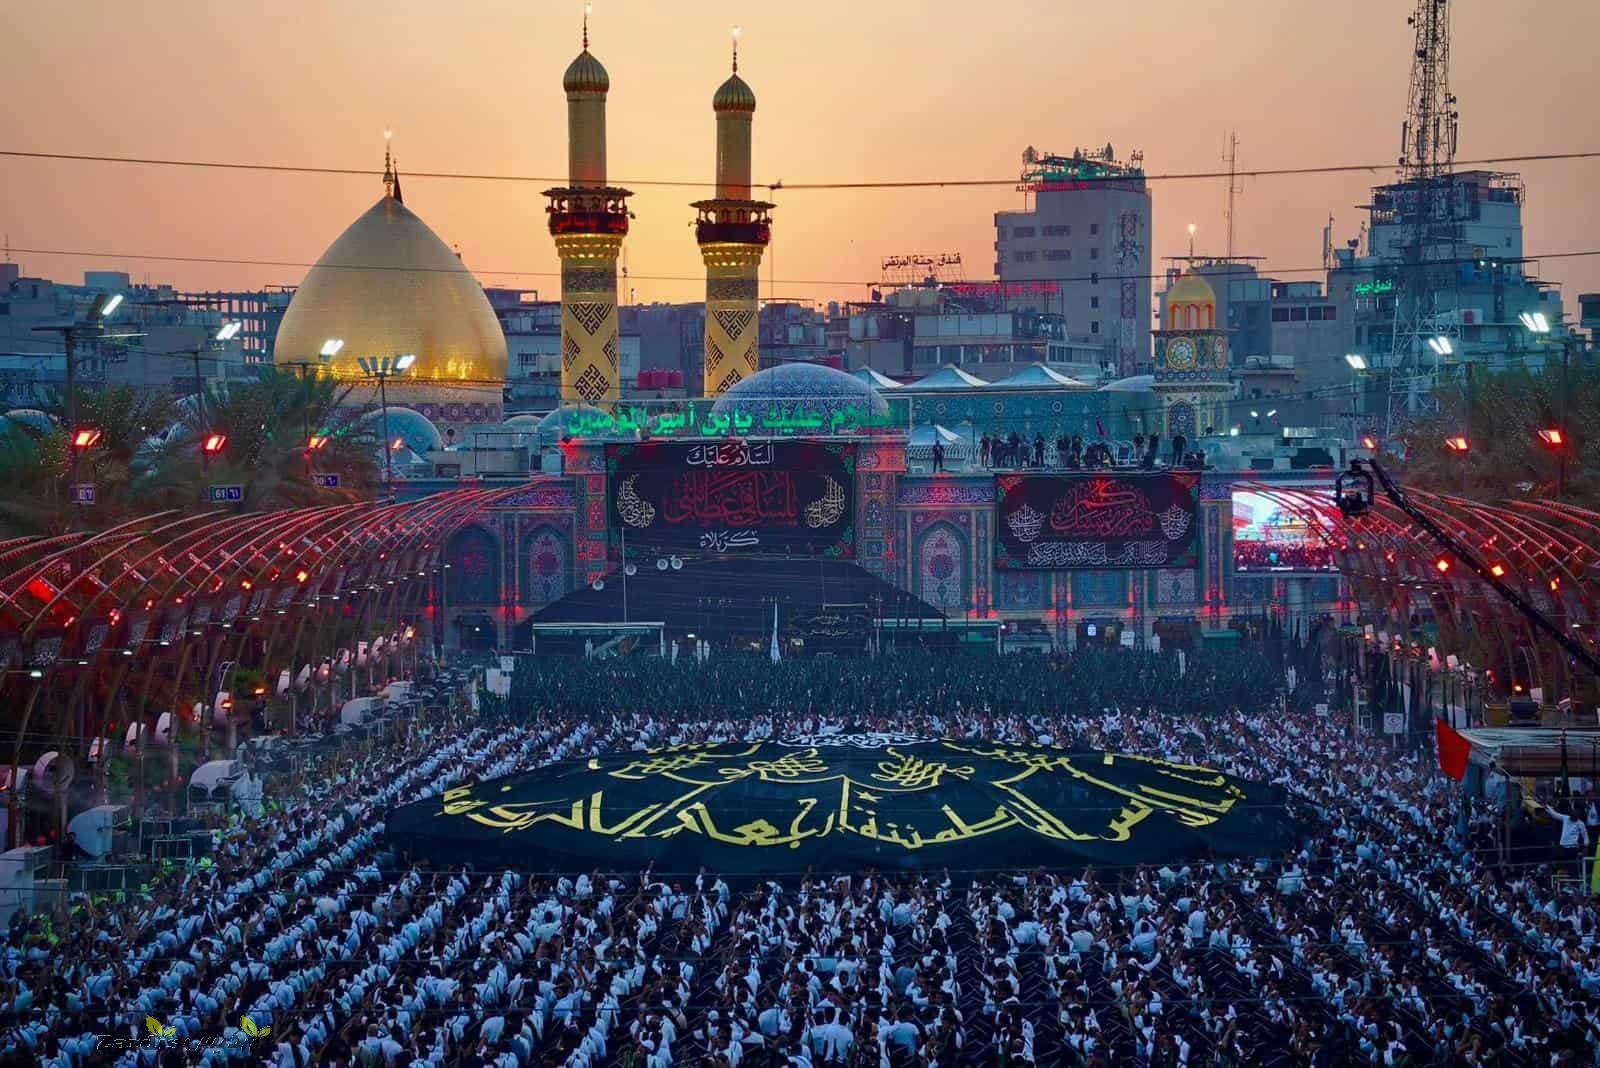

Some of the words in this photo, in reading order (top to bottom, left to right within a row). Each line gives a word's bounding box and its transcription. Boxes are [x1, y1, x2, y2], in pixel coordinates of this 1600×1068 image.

[937, 252, 961, 266] فندق
[650, 401, 697, 434] أمير
[762, 407, 823, 434] عليك
